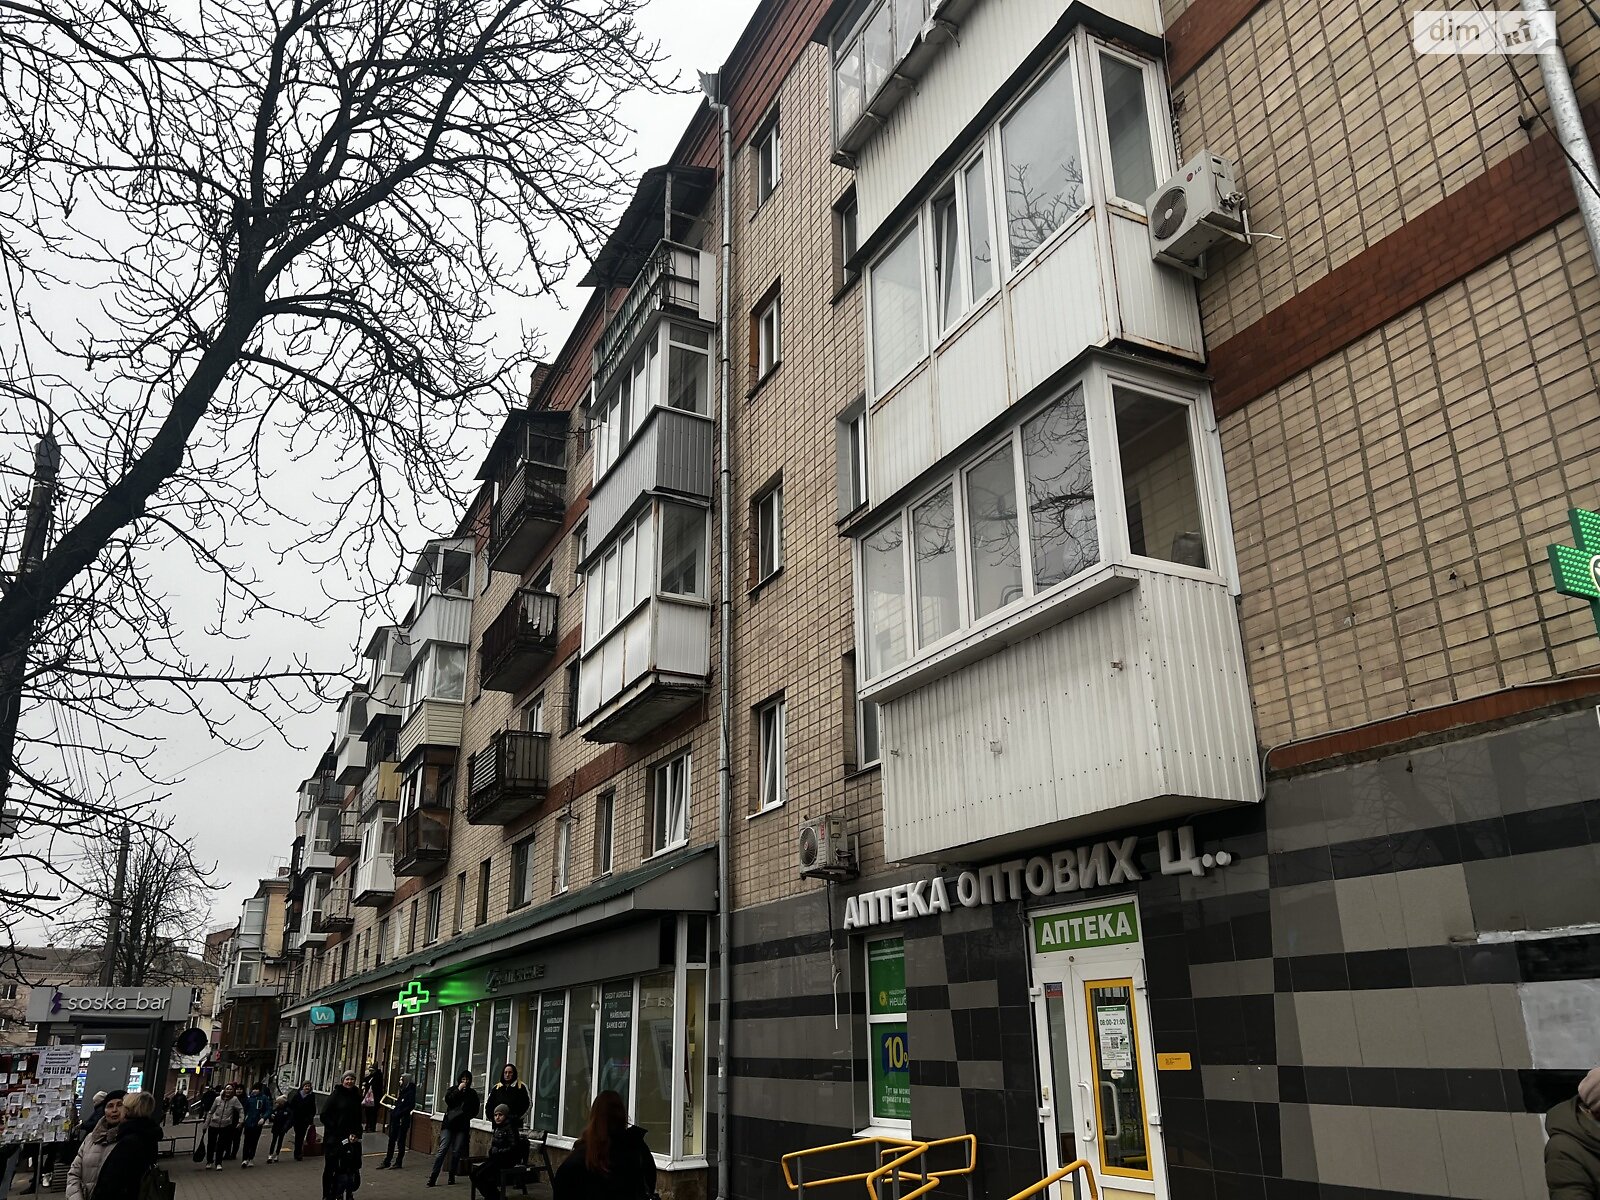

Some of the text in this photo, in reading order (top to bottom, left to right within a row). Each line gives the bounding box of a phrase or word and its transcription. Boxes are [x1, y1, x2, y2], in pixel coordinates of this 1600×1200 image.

[1194, 165, 1202, 176] LG
[843, 876, 951, 929] АПТЕКА
[956, 836, 1142, 908] ОПТОВИХ
[1040, 911, 1132, 946] АПТЕКА
[67, 991, 170, 1010] soska bar
